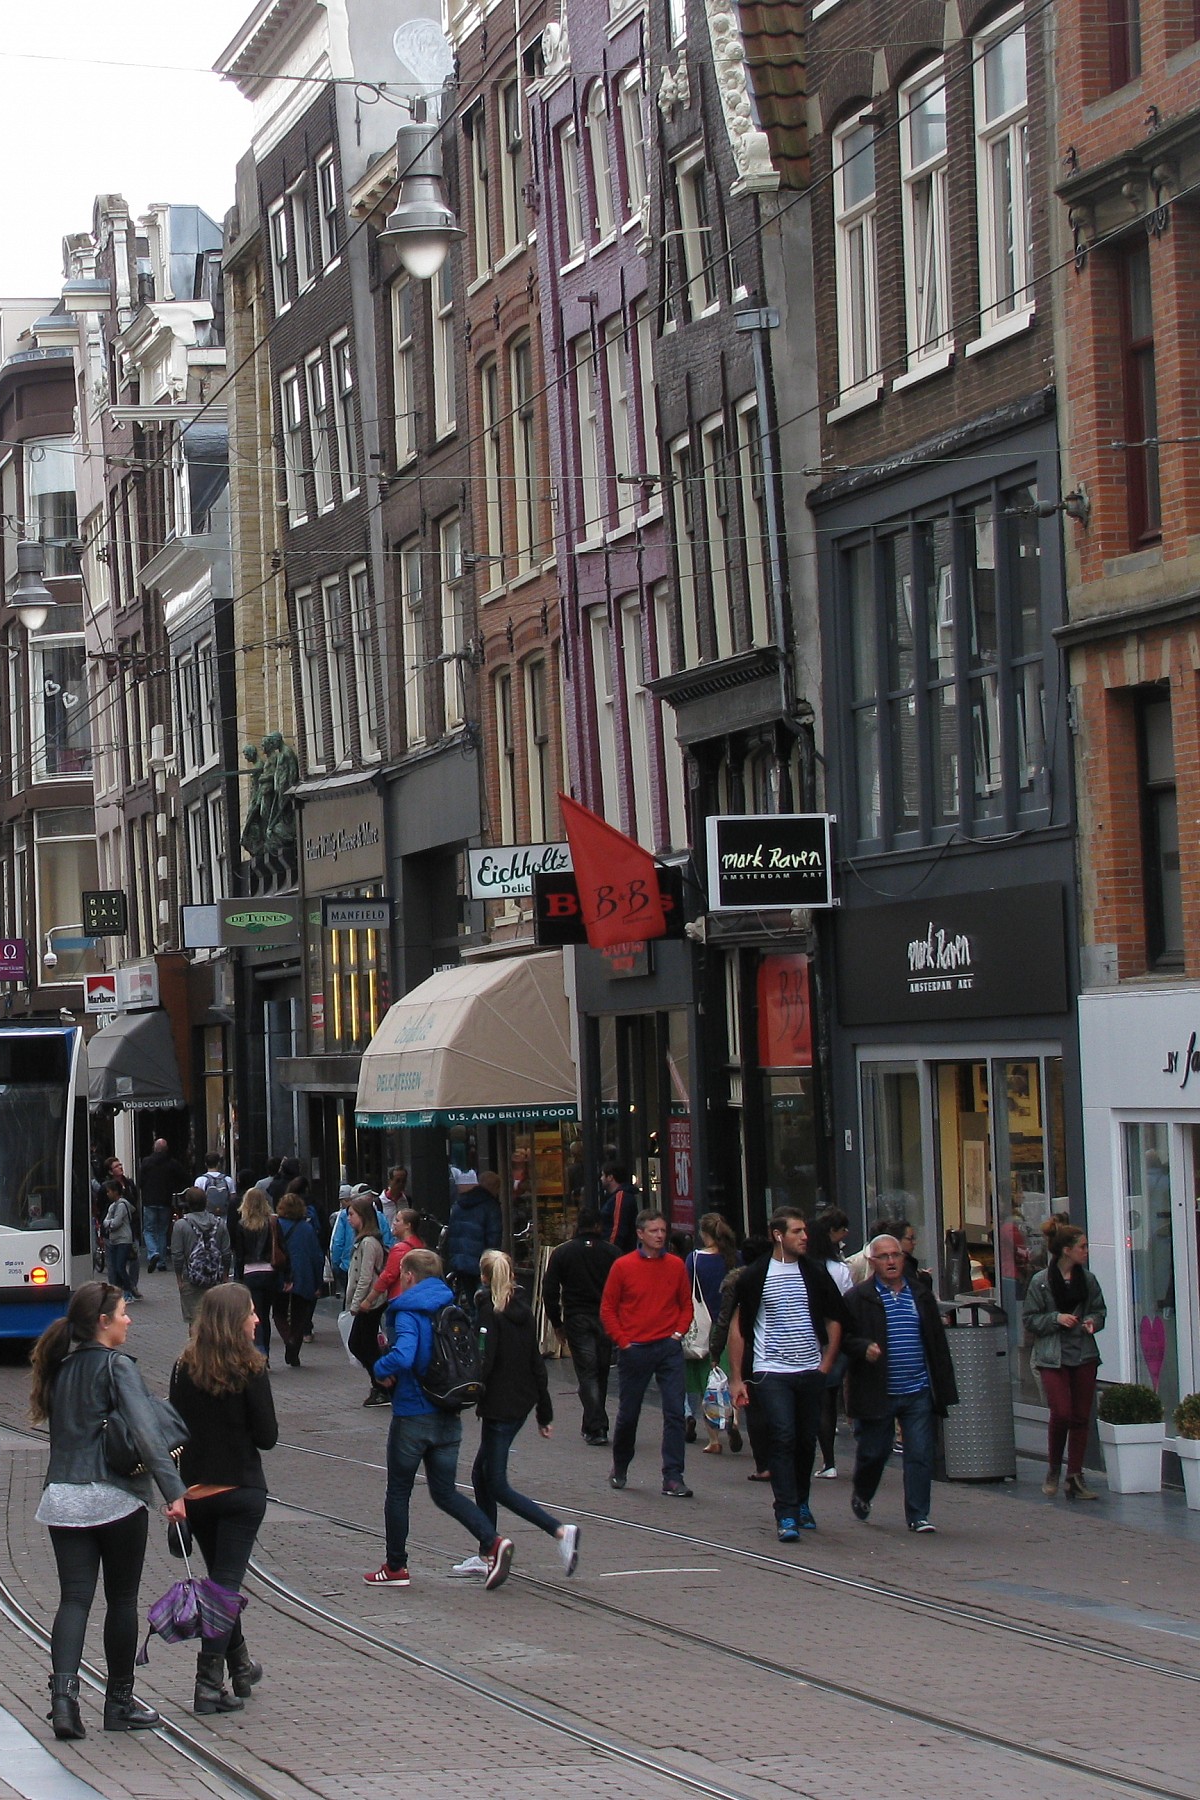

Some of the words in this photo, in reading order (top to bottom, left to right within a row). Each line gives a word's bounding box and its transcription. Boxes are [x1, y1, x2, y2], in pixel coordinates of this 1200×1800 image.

[768, 847, 823, 869] Raven
[477, 847, 570, 887] Eichholtz
[722, 872, 791, 881] AMSTERDAM
[802, 871, 823, 879] ART
[331, 910, 385, 921] MANFIELD
[909, 980, 952, 993] AMSTERDAM
[957, 979, 973, 990] ART
[88, 993, 116, 1004] Marlboro
[377, 1071, 422, 1092] DELICATESSEN
[121, 1098, 178, 1109] Tobacconist
[447, 1113, 469, 1121] U.S.
[471, 1112, 496, 1120] AND
[499, 1109, 540, 1119] BRITISH
[542, 1108, 575, 1117] FOOD
